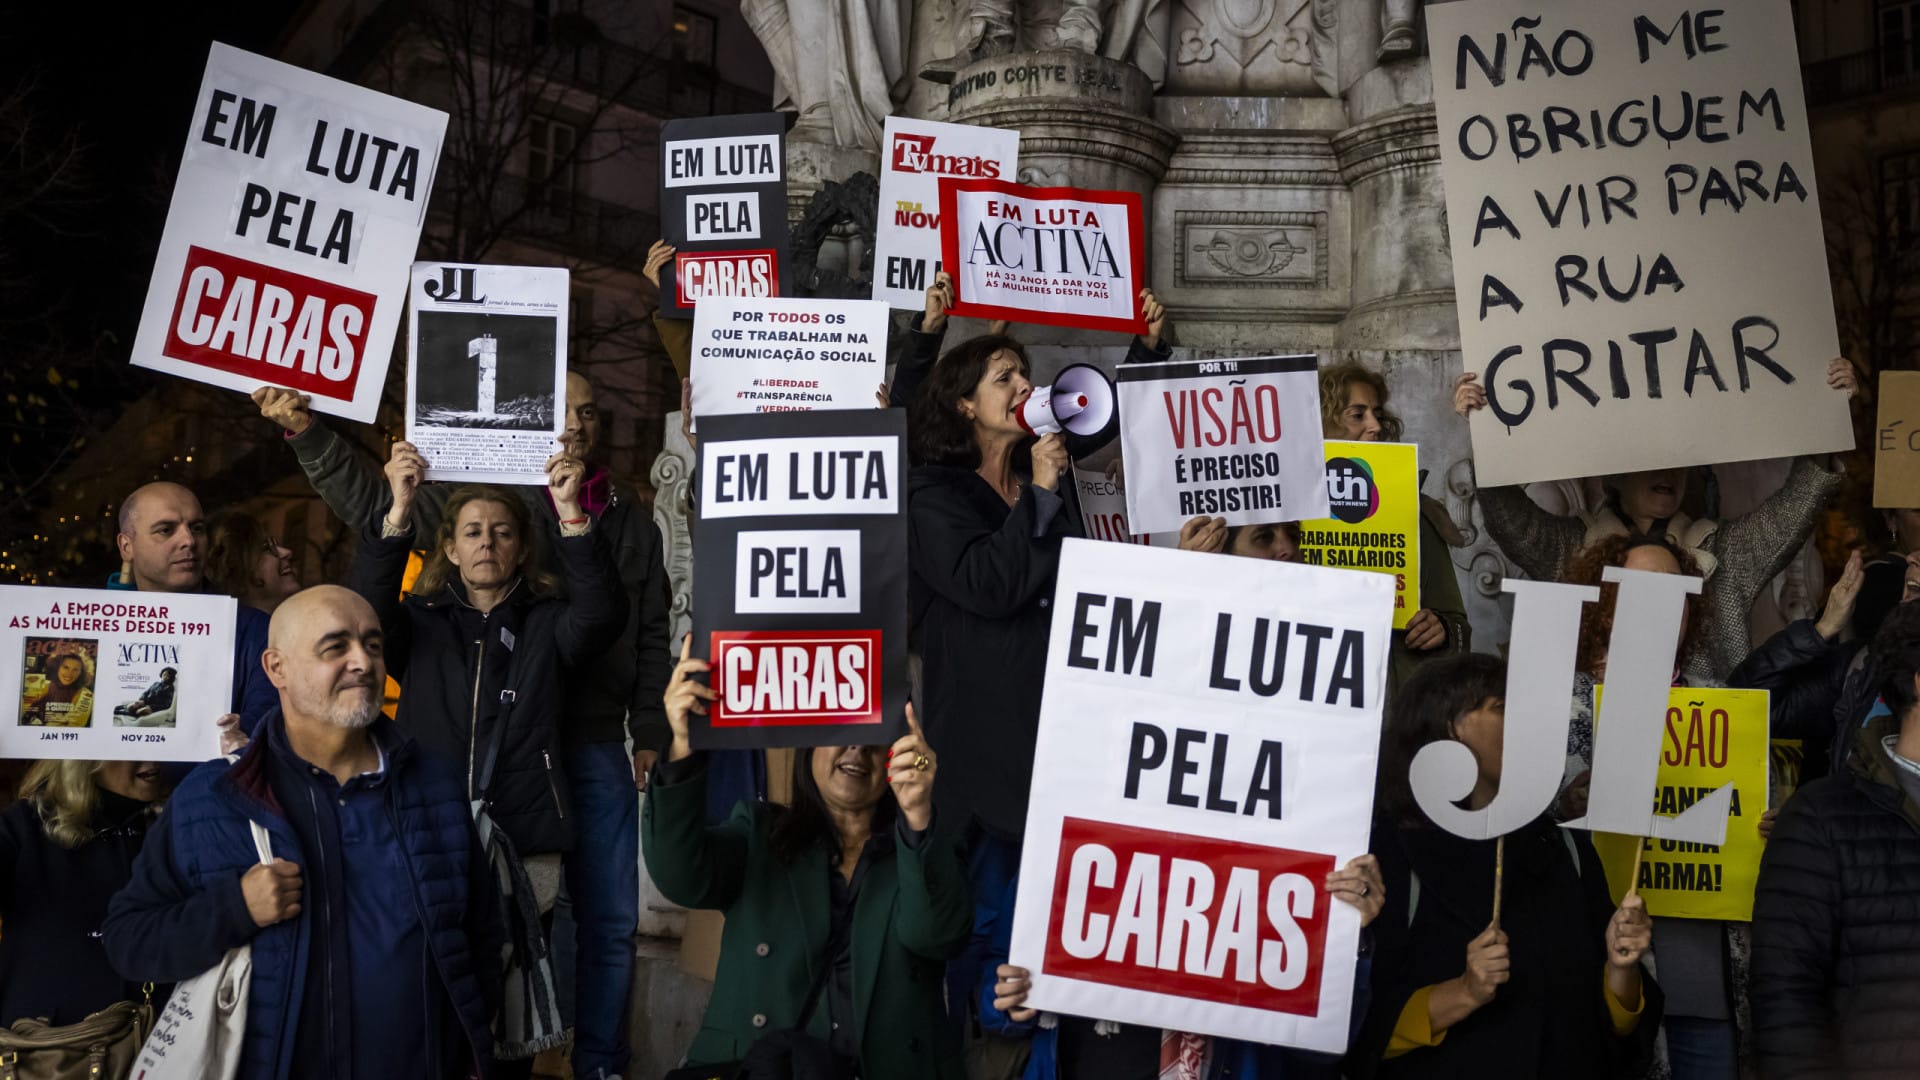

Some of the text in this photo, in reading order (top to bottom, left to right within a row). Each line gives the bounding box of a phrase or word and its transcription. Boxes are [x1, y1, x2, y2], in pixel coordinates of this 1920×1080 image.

[1455, 10, 1728, 89] NÃO ME
[1004, 65, 1066, 84] CORTE
[1459, 88, 1785, 162] OBRIGUEM
[201, 88, 420, 203] EM LUTA
[671, 144, 774, 178] EM LUTA
[694, 201, 752, 234] PELA
[895, 211, 940, 229] NOV
[987, 200, 1100, 228] EM LUTA
[1473, 161, 1807, 247] A VIR PARA
[234, 183, 354, 265] PELA
[967, 220, 1124, 278] ACTIVA
[423, 267, 487, 306] JL
[685, 258, 769, 299] CARAS
[886, 256, 926, 291] EM
[1002, 281, 1052, 294] MULHERES
[1055, 287, 1083, 296] DESTE
[1004, 272, 1016, 281] 33
[1020, 275, 1048, 285] ANOS
[1063, 279, 1082, 287] DAR
[1086, 281, 1107, 289] VOZ
[1479, 252, 1684, 321] A RUA
[176, 266, 364, 381] CARAS
[732, 311, 846, 325] POR TODOS OS
[711, 329, 868, 344] QUE TRABALHAM NA
[700, 347, 877, 363] COMUNICAÇÃO SOCIAL
[1199, 362, 1221, 374] POR
[753, 379, 819, 389] #LIBERDADE
[1483, 316, 1795, 435] GRITAR
[736, 391, 832, 402] #TRANSPARÊNCIA
[1163, 379, 1281, 449] VISÃO
[1880, 420, 1903, 451] É
[715, 450, 888, 503] EM LUTA
[1175, 452, 1280, 483] É PRECISO
[1179, 484, 1282, 515] RESISTIR!
[1300, 530, 1405, 548] RABALHADORES
[750, 547, 846, 598] PELA
[1300, 546, 1405, 568] EM SALÁRIOS
[9, 616, 210, 636] AS MULHERES DESDE 1991
[50, 602, 168, 618] A EMPODERAR
[117, 643, 179, 664] ACTIVA
[1066, 591, 1365, 709] EM LUTA
[725, 644, 865, 713] CARAS
[40, 732, 79, 741] JAN 1991
[121, 734, 166, 742] NOV 2024
[1664, 701, 1729, 768] SÃO
[1123, 721, 1282, 821] PELA
[1638, 861, 1722, 892] ARMA!
[1061, 843, 1315, 991] CARAS
